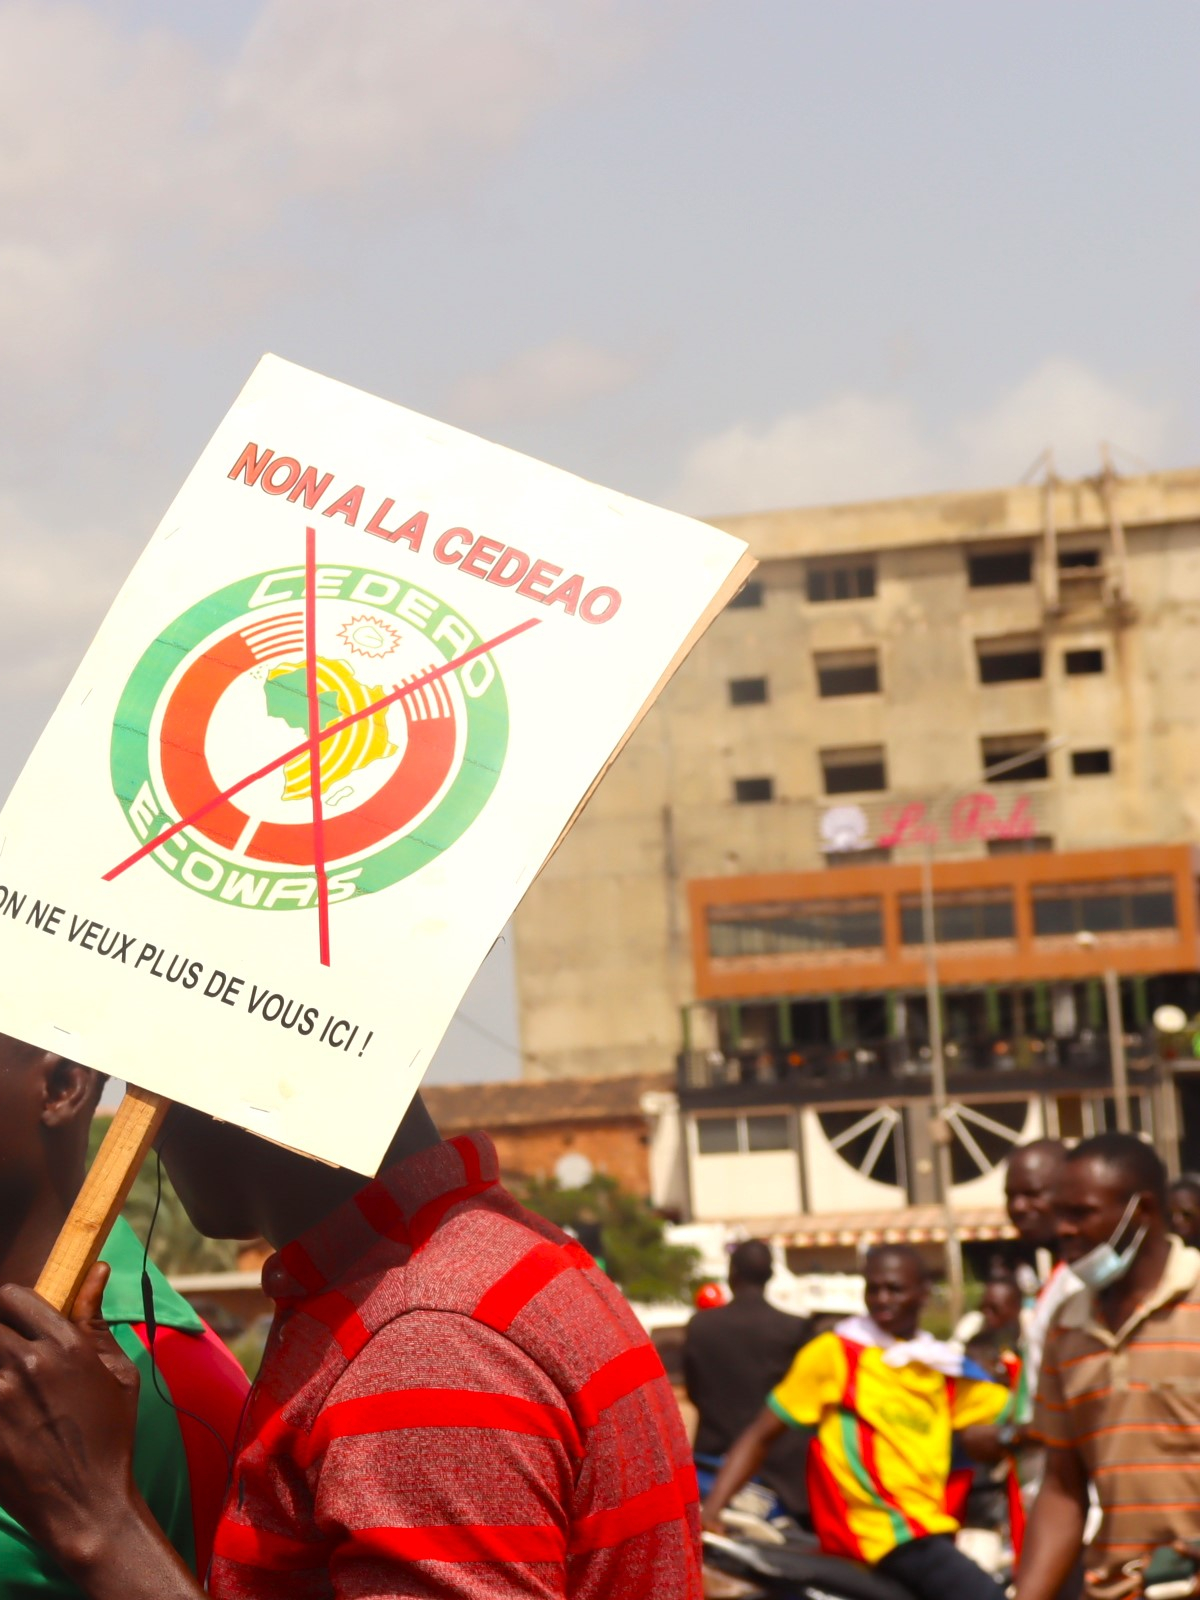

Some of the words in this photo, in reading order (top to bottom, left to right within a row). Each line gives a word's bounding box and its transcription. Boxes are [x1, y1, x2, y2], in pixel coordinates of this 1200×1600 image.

[227, 442, 335, 510] NON
[322, 485, 365, 527] A
[364, 498, 429, 553] LA
[433, 527, 622, 624] CEDEAO
[248, 568, 495, 698] CEDEAO
[128, 780, 363, 908] ECOWAS
[25, 900, 66, 935] NE
[68, 914, 137, 963] VEUX
[134, 943, 204, 989] PLUS
[203, 970, 245, 1006] DE
[248, 985, 319, 1035] VOUS
[319, 1016, 359, 1051] ICI
